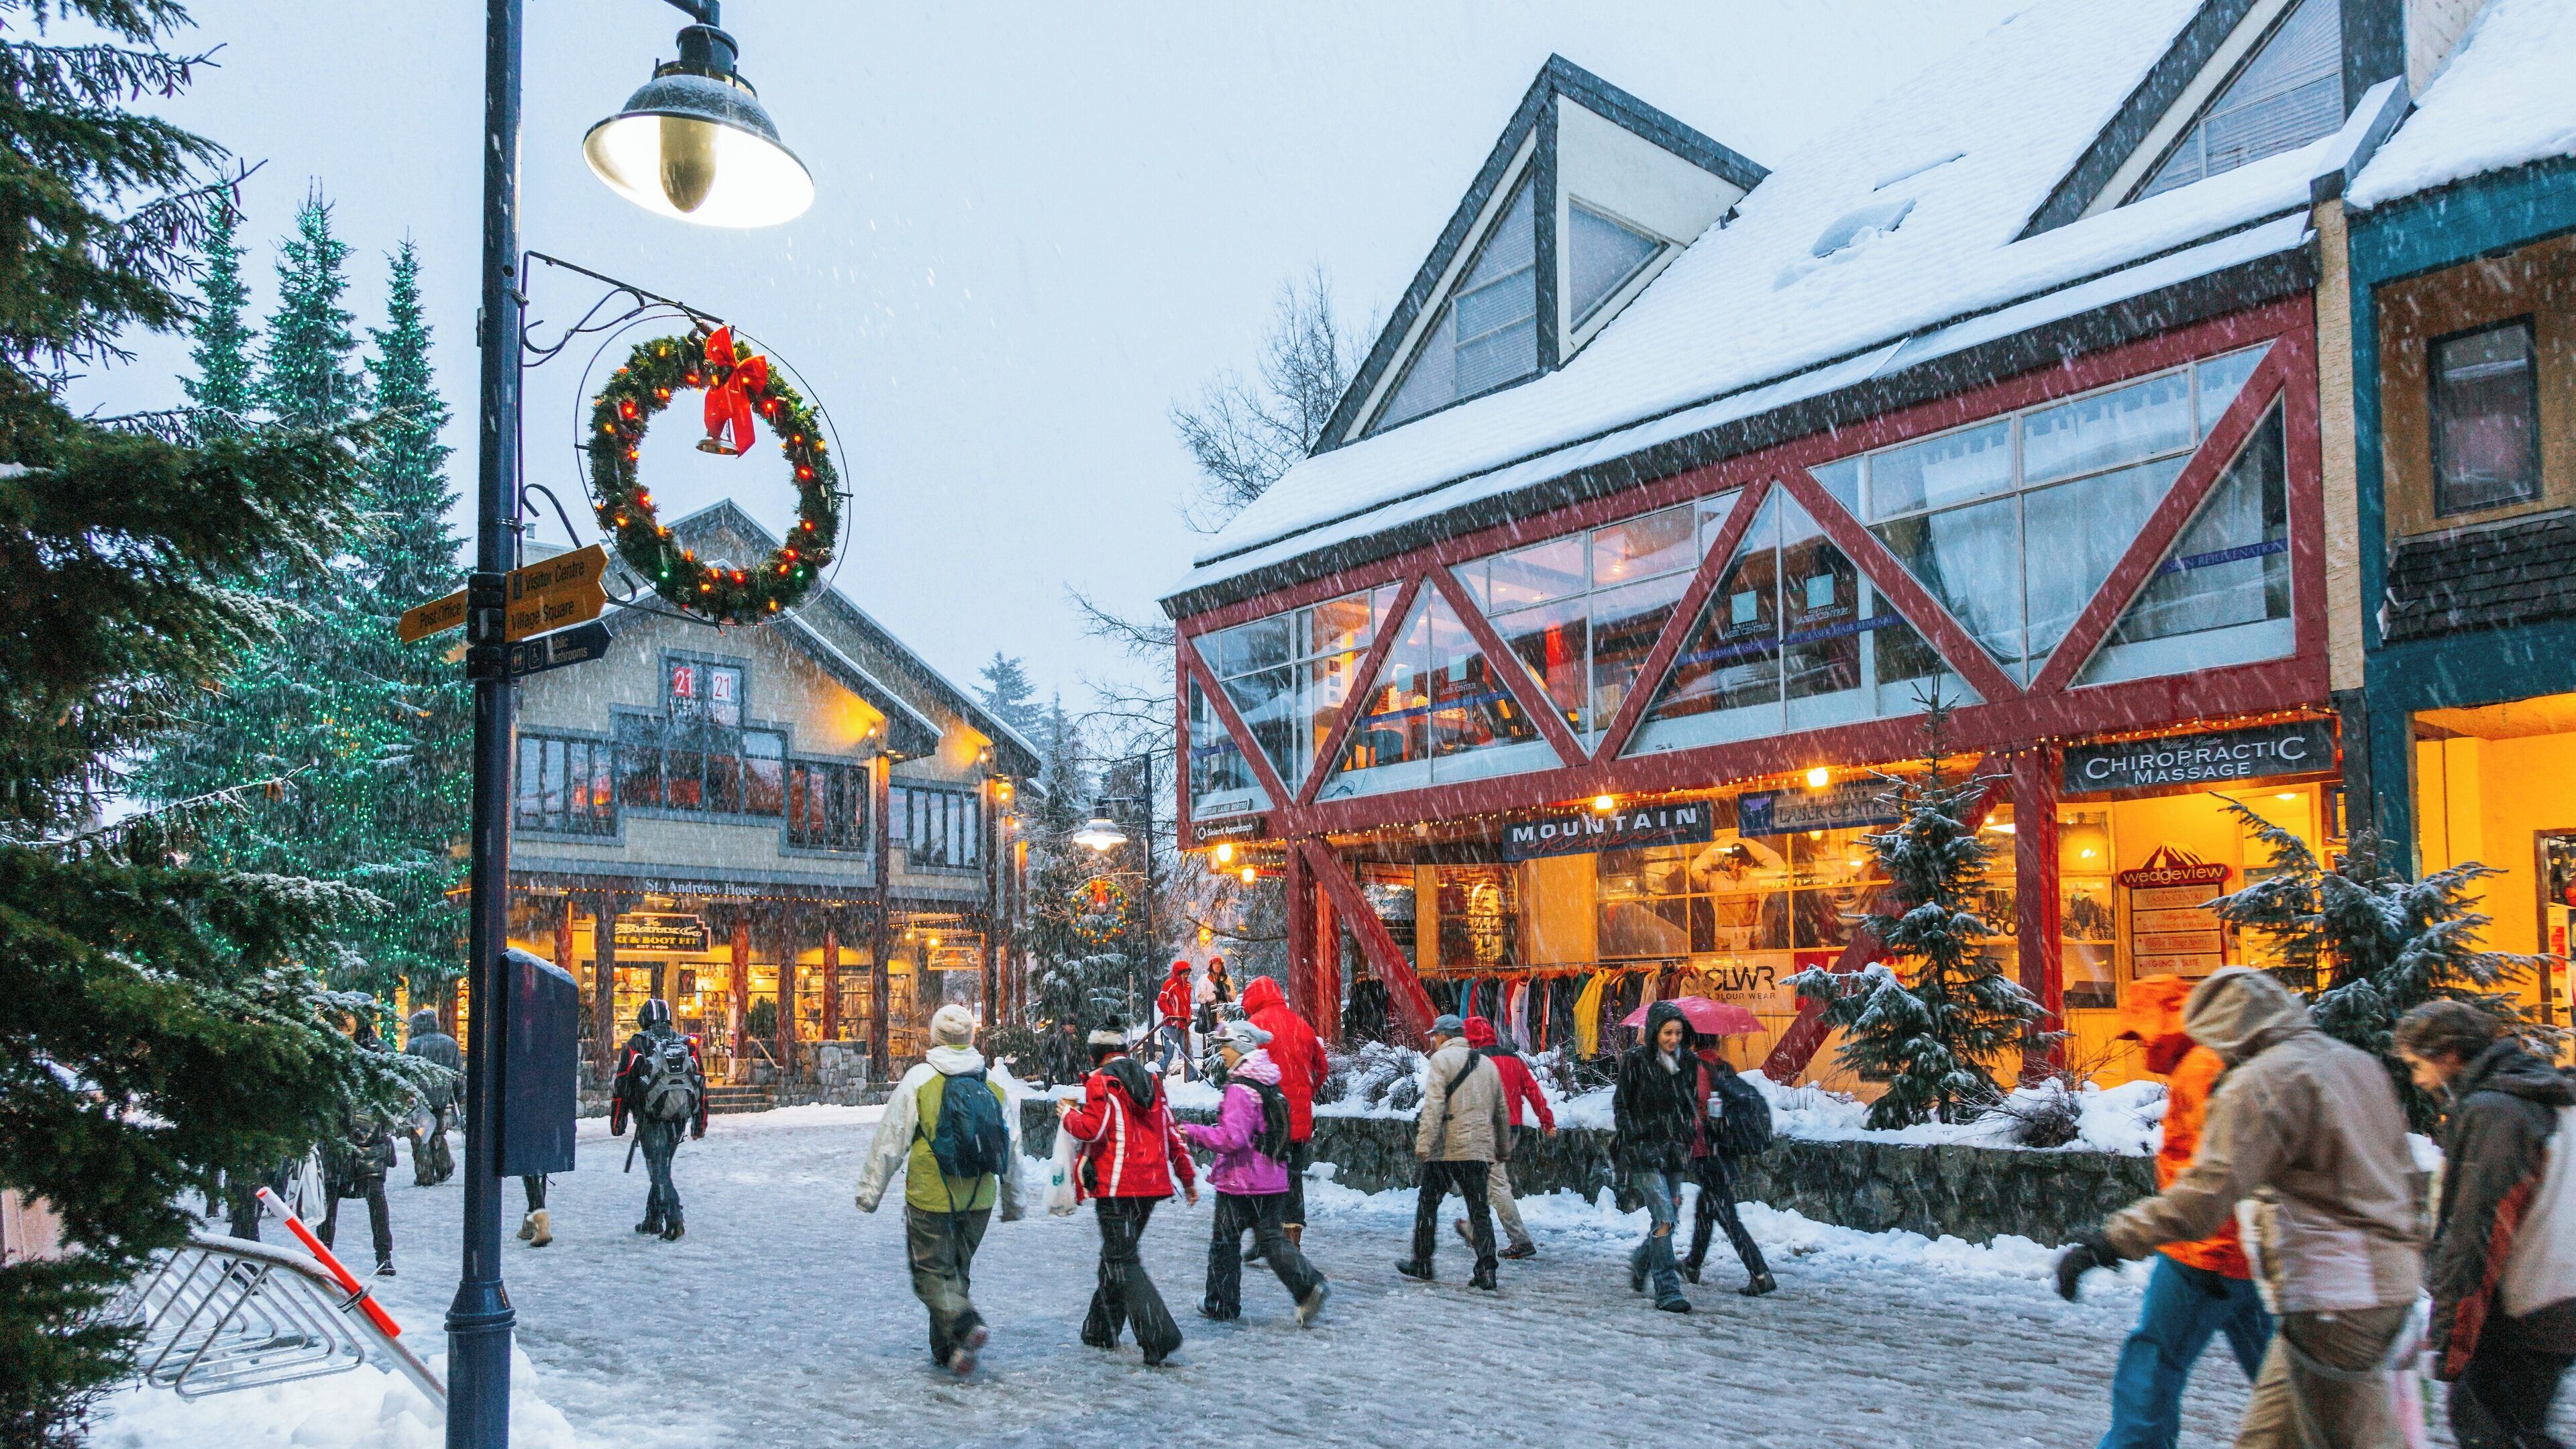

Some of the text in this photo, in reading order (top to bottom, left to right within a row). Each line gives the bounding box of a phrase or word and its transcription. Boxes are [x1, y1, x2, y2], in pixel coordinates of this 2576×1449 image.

[2198, 542, 2285, 566] REJUVENATION
[525, 561, 585, 592] Visitor Centre
[419, 602, 462, 629] Post Office
[511, 601, 575, 631] Village Square
[1807, 615, 1894, 640] LASER HAIR REMOVAL
[547, 636, 568, 651] Public
[546, 647, 588, 665] Washrooms
[676, 670, 730, 698] 21 21
[2085, 736, 2308, 780] CHIROPRACTIC
[2134, 761, 2251, 785] MASSAGE
[1779, 799, 1888, 824] LASER CENTR
[1225, 822, 1253, 835] Approach
[1512, 808, 1697, 843] MOUNTAIN
[645, 879, 760, 896] St. Andrews House
[2123, 866, 2225, 885] wedgeview
[630, 936, 640, 945] &
[642, 936, 676, 945] BOOT
[678, 937, 697, 945] FIT
[2181, 959, 2199, 967] SUITE
[1748, 992, 1776, 1000] WEAR
